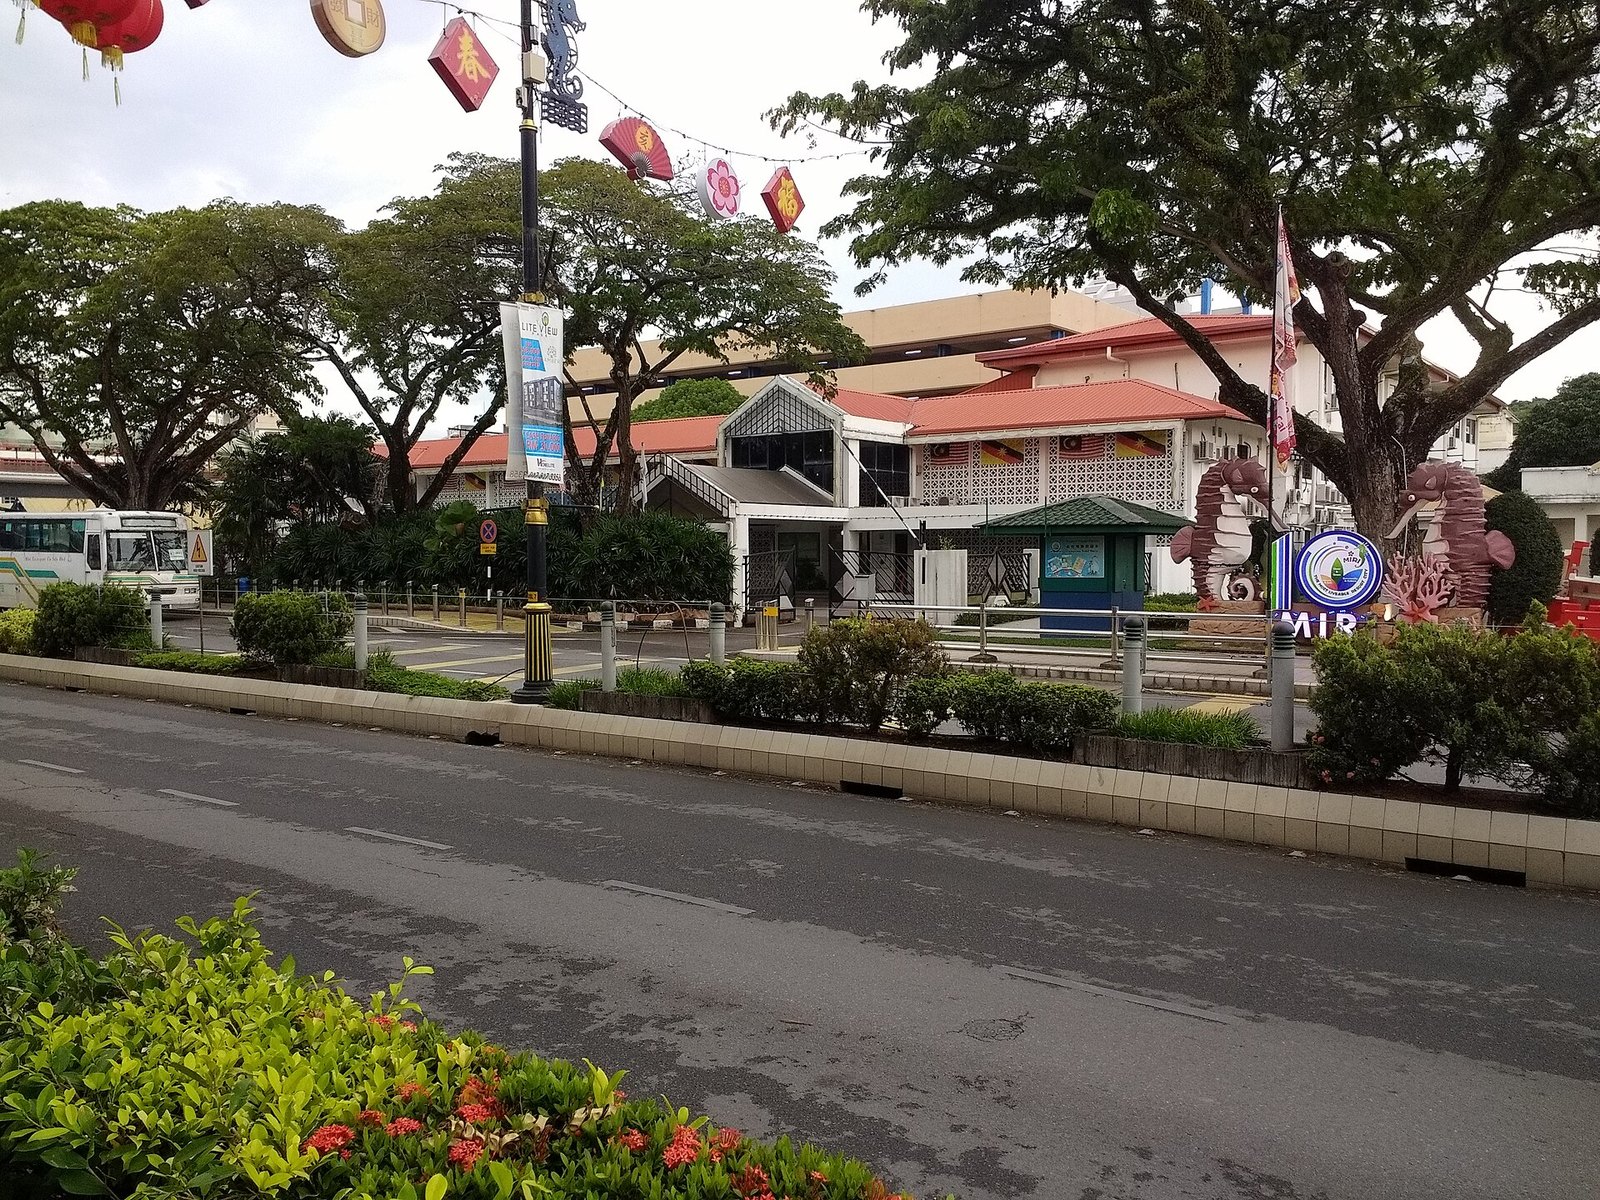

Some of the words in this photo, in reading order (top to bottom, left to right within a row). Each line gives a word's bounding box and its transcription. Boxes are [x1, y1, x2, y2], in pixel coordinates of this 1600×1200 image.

[455, 25, 492, 83] 春
[777, 175, 799, 219] 福
[521, 322, 537, 333] LITE
[539, 323, 558, 336] VIEW
[1343, 556, 1361, 564] MIRI
[1318, 581, 1329, 594] MOST
[1351, 580, 1364, 594] RESORT
